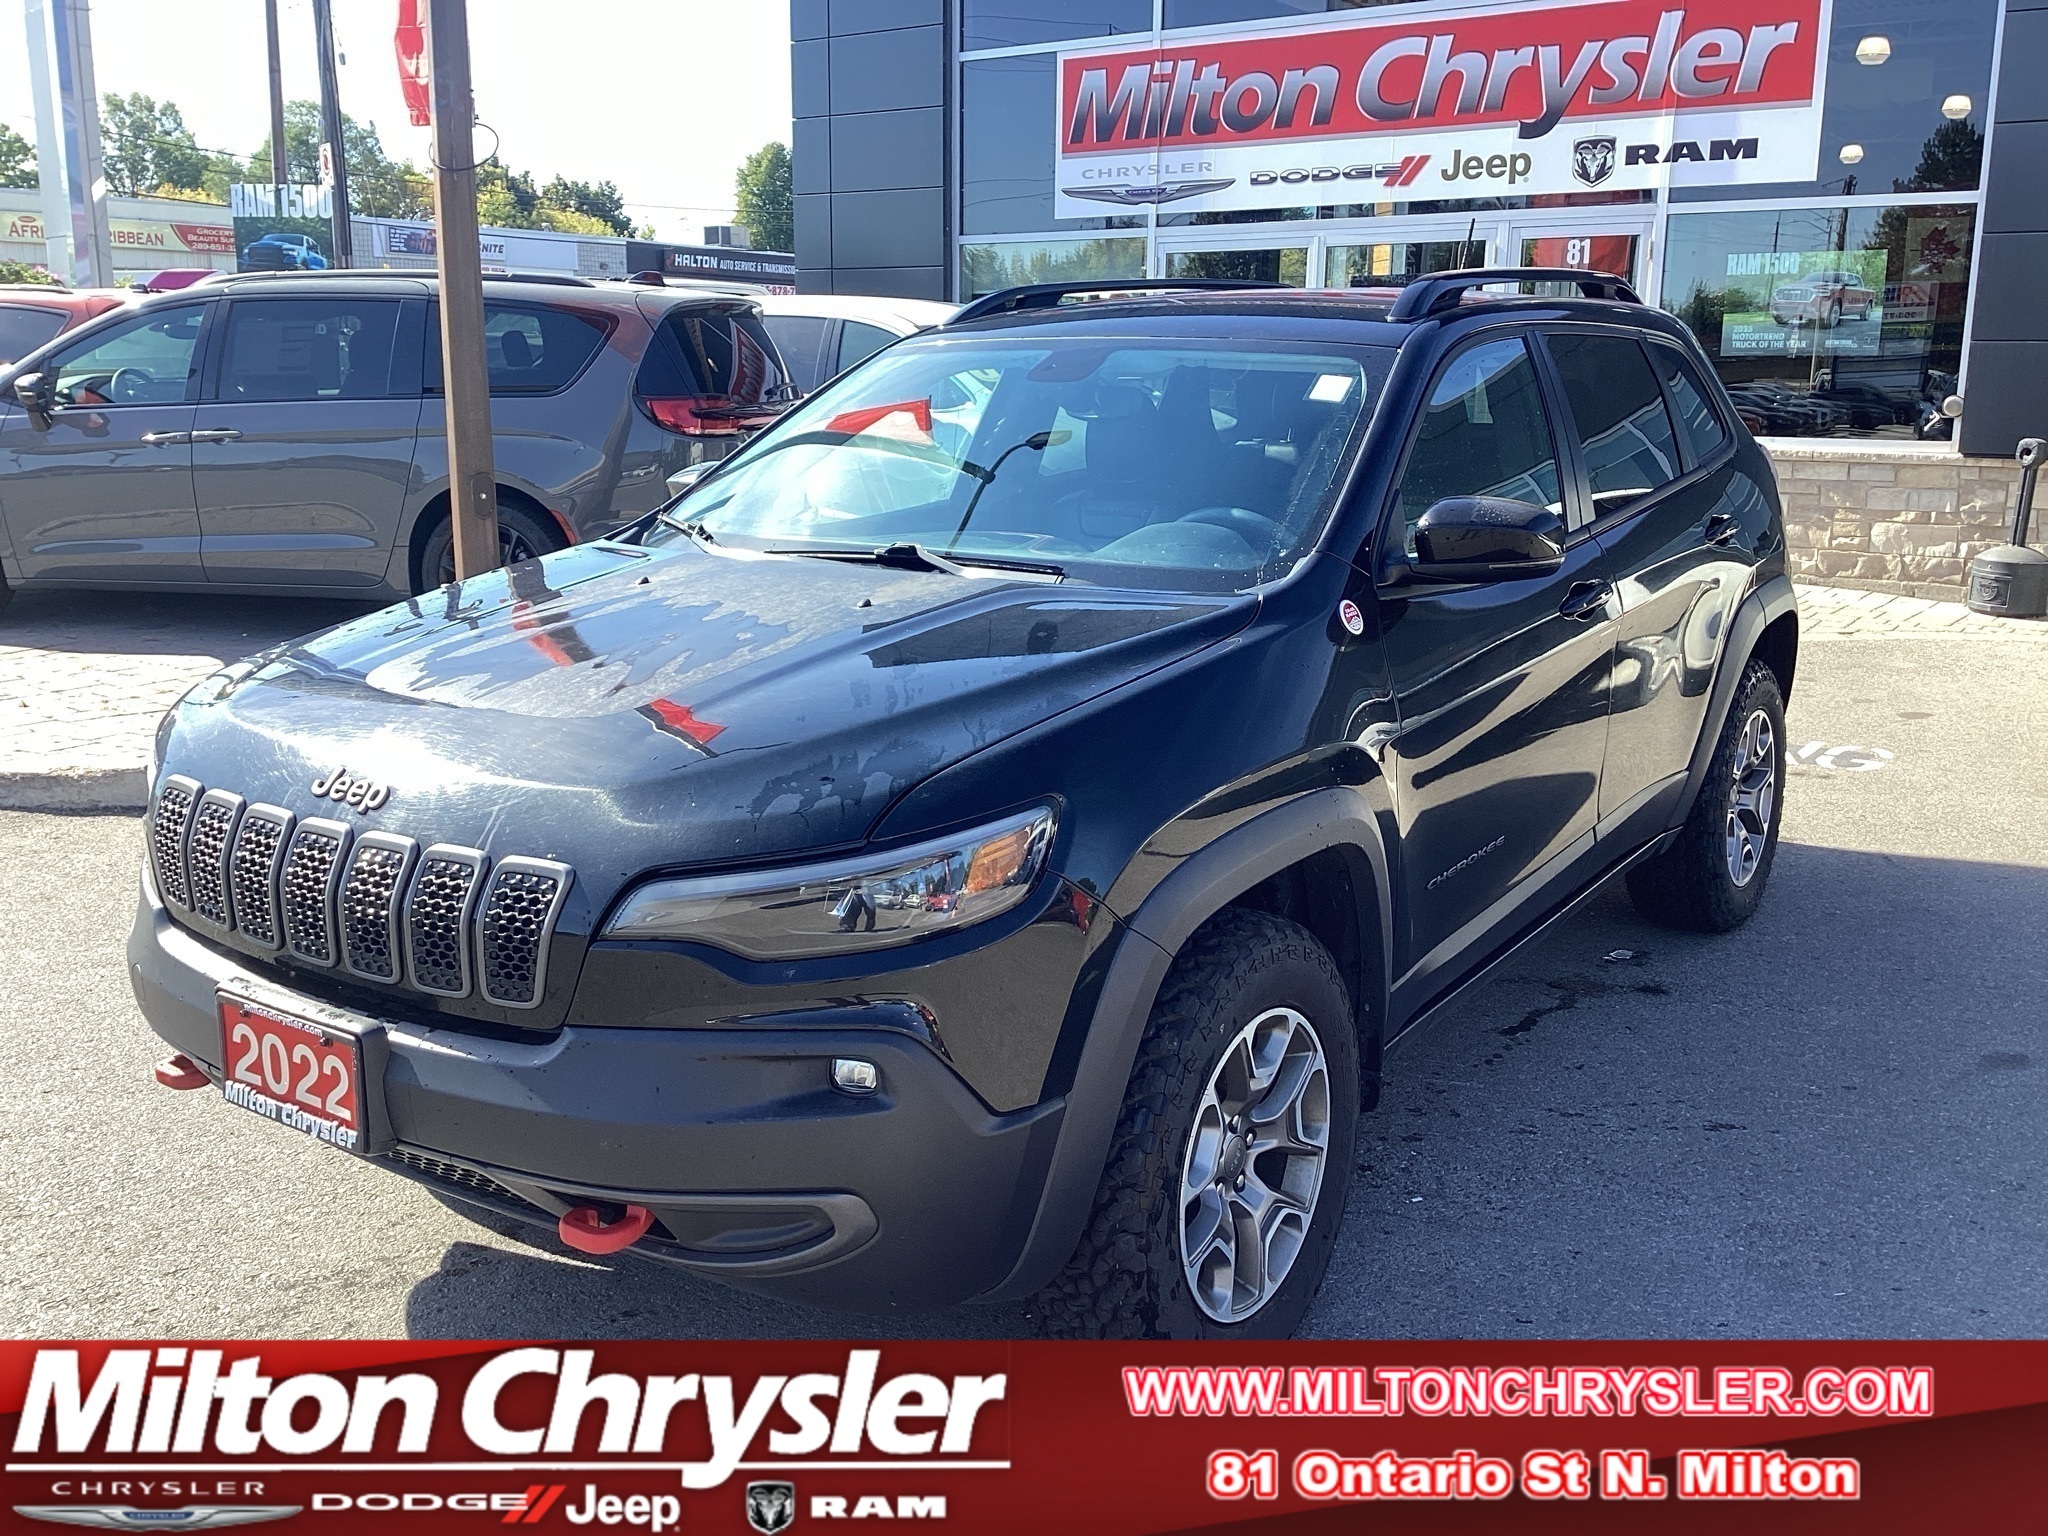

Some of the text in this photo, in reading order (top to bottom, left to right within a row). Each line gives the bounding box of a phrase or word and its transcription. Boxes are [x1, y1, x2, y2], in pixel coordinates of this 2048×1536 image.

[1067, 8, 1801, 145] Milton Chrysler
[1624, 137, 1760, 166] RAM
[1081, 160, 1214, 180] CHRYSLER
[1249, 162, 1406, 186] DODGE
[1440, 148, 1532, 185] Jeep
[230, 183, 333, 219] RAM 1500
[187, 234, 218, 242] BEAUTY
[480, 243, 504, 254] NITE
[674, 253, 718, 269] HALTON
[719, 259, 734, 271] AUTO
[734, 260, 757, 272] SERVICE
[1566, 239, 1591, 265] 81
[1726, 251, 1799, 276] RAM 1500
[1731, 332, 1785, 341] MOTORTREND
[1733, 325, 1753, 333] 2025
[1731, 340, 1807, 349] TRUCK OF THE YEAR
[310, 766, 391, 816] Jeep
[1426, 834, 1506, 891] CHEROKEE
[232, 1023, 352, 1122] 2022
[224, 1079, 358, 1149] Milton Chrysler
